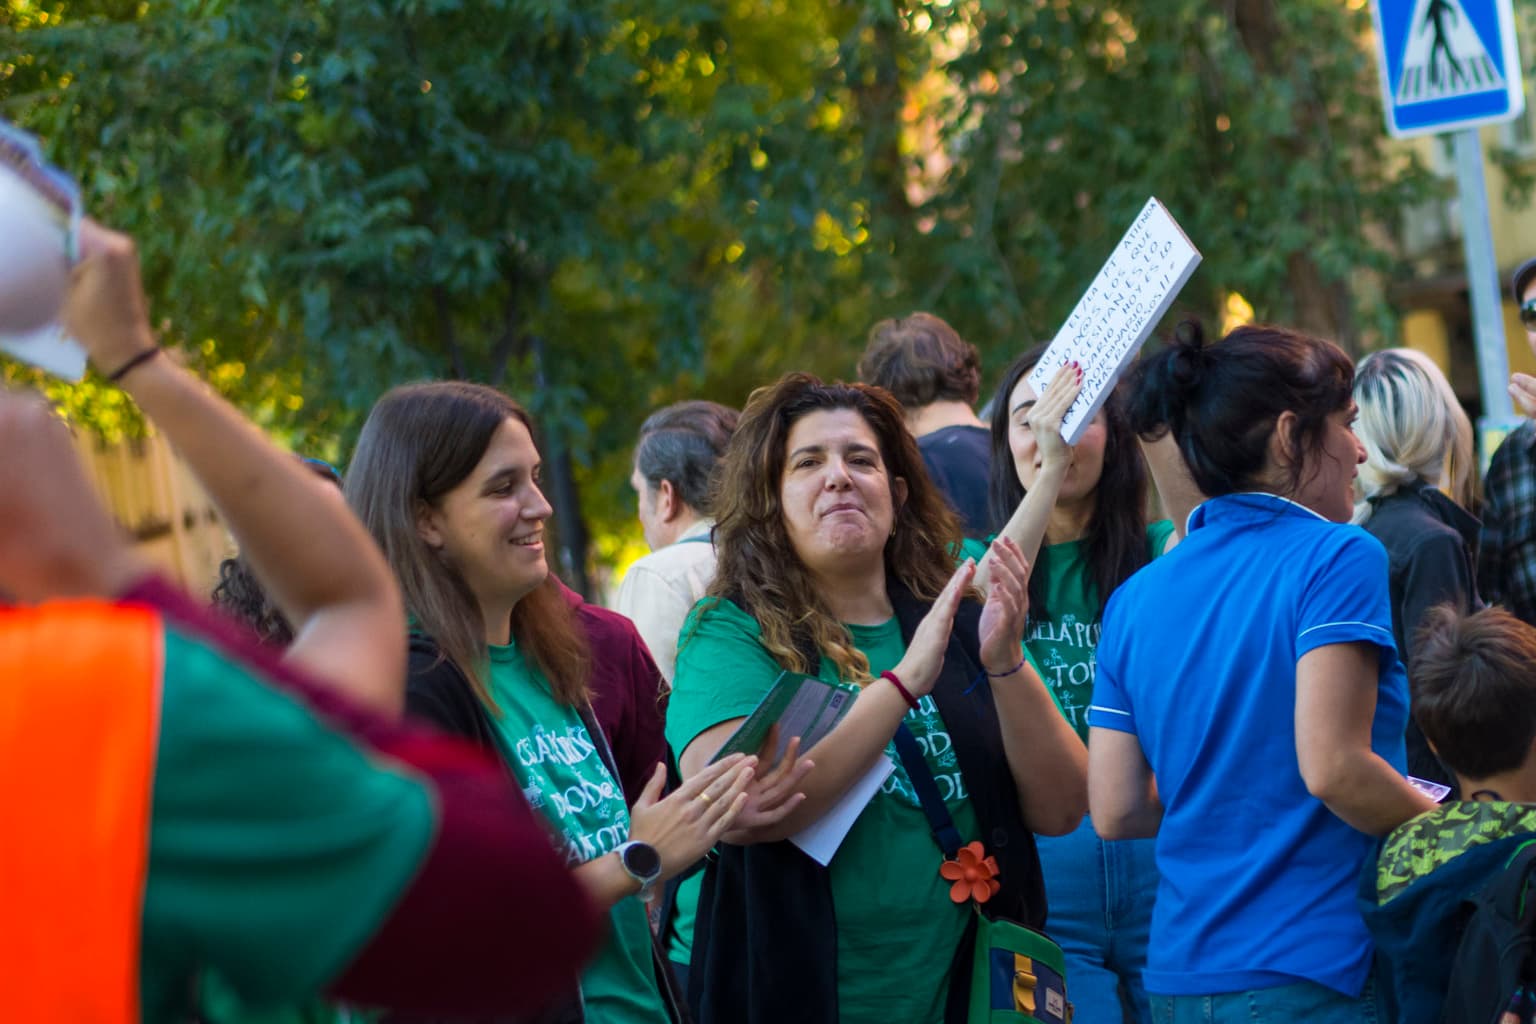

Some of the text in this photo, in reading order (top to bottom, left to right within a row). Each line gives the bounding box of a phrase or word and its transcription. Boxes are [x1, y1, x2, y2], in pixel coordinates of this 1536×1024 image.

[1102, 268, 1126, 301] LOS
[1130, 229, 1153, 261] QUE
[1123, 201, 1158, 250] ATIENDA
[1079, 240, 1159, 358] CESITAN ES LO
[1081, 326, 1115, 376] NARIO
[1121, 284, 1143, 315] HOY
[1144, 263, 1160, 284] ES
